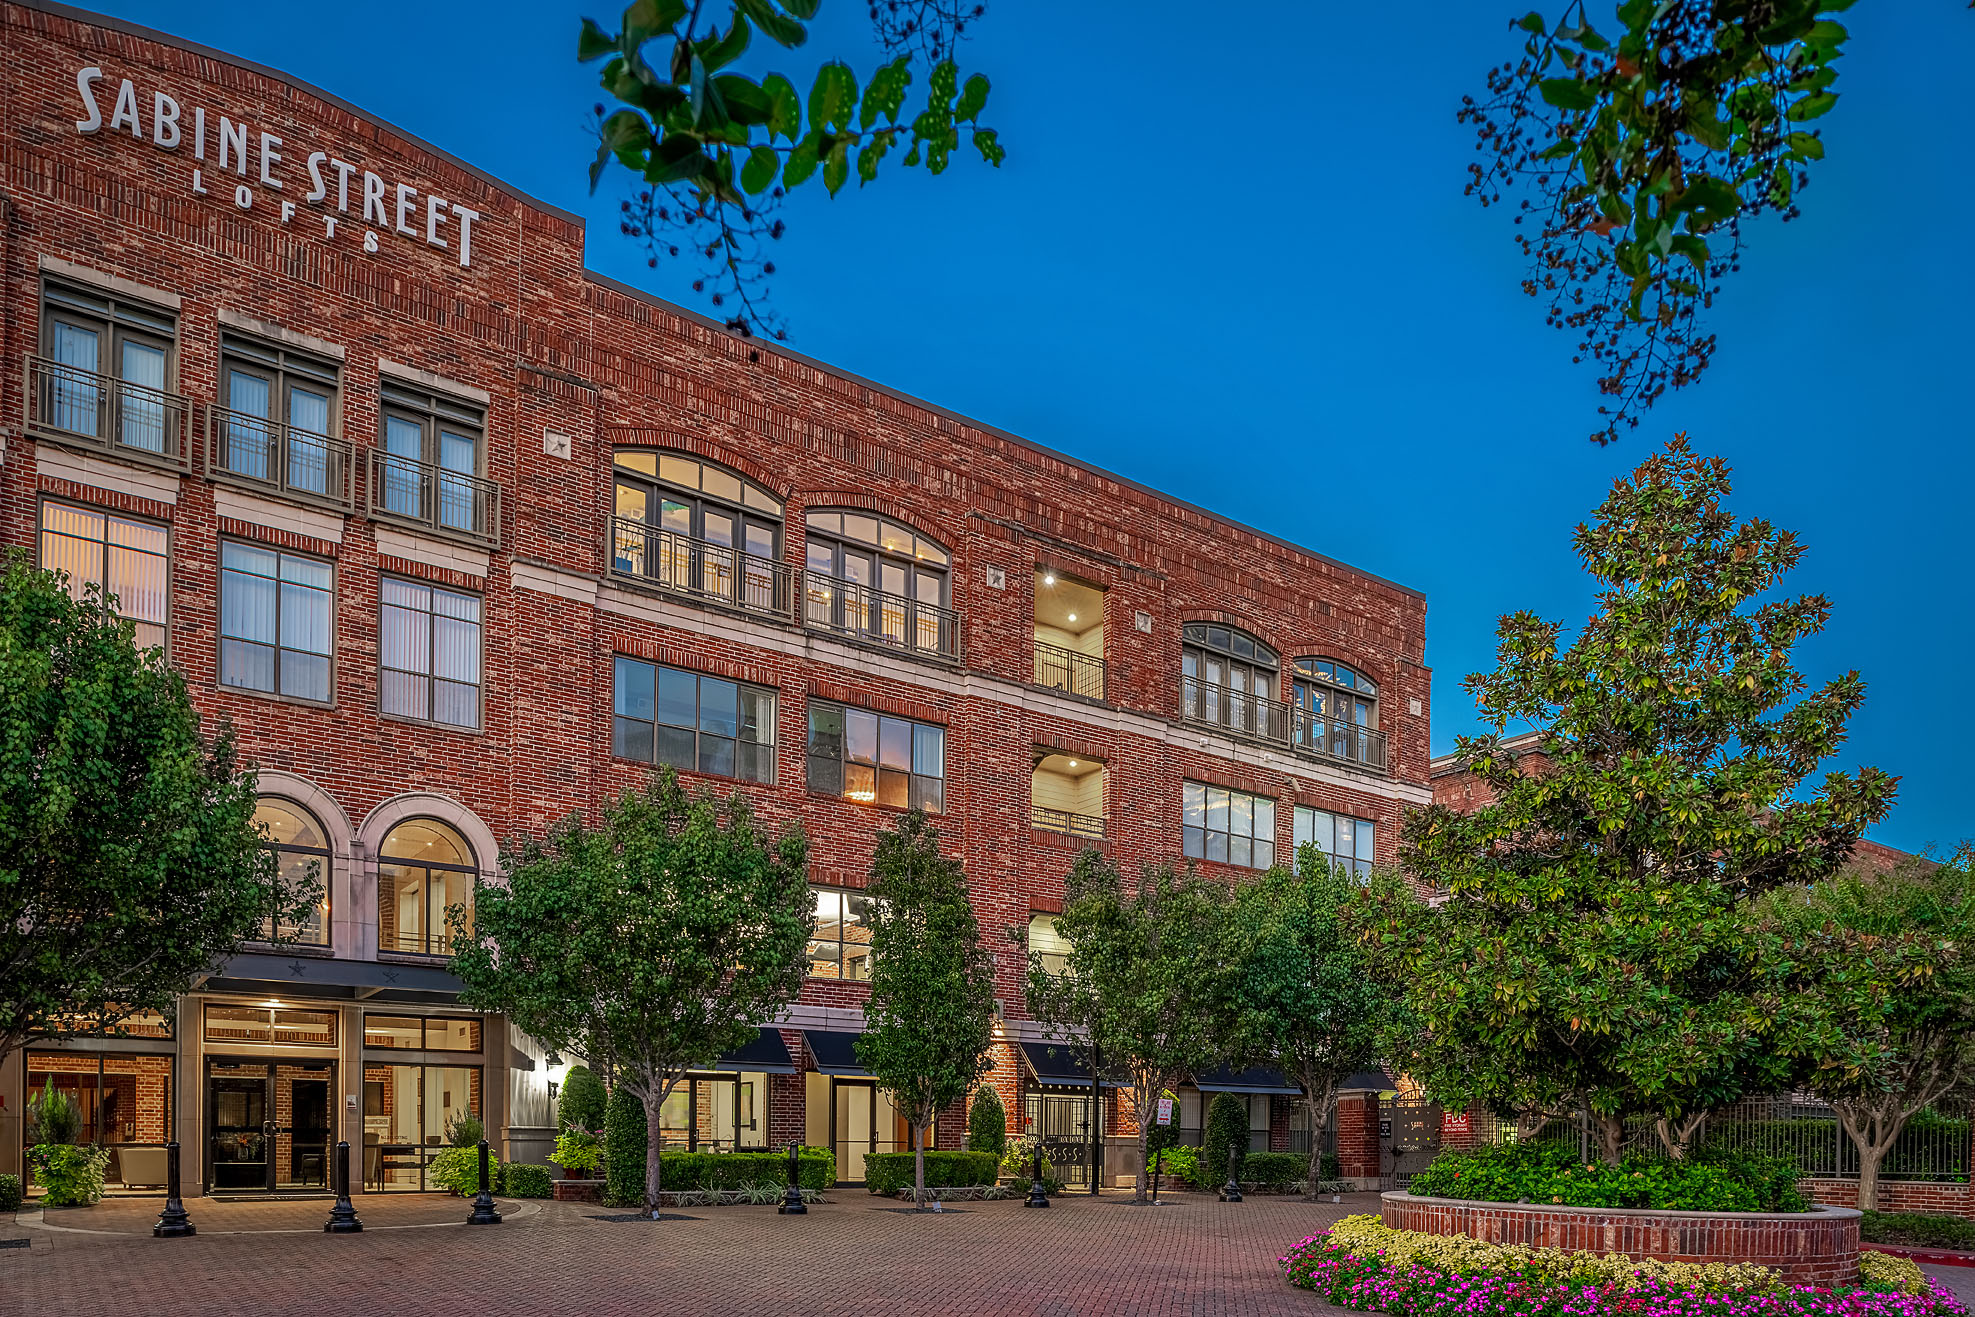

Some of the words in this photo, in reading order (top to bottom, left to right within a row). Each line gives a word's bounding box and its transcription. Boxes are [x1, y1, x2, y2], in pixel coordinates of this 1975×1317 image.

[76, 66, 284, 190] SABINE
[306, 151, 480, 267] STREET
[193, 169, 379, 254] LOFTS
